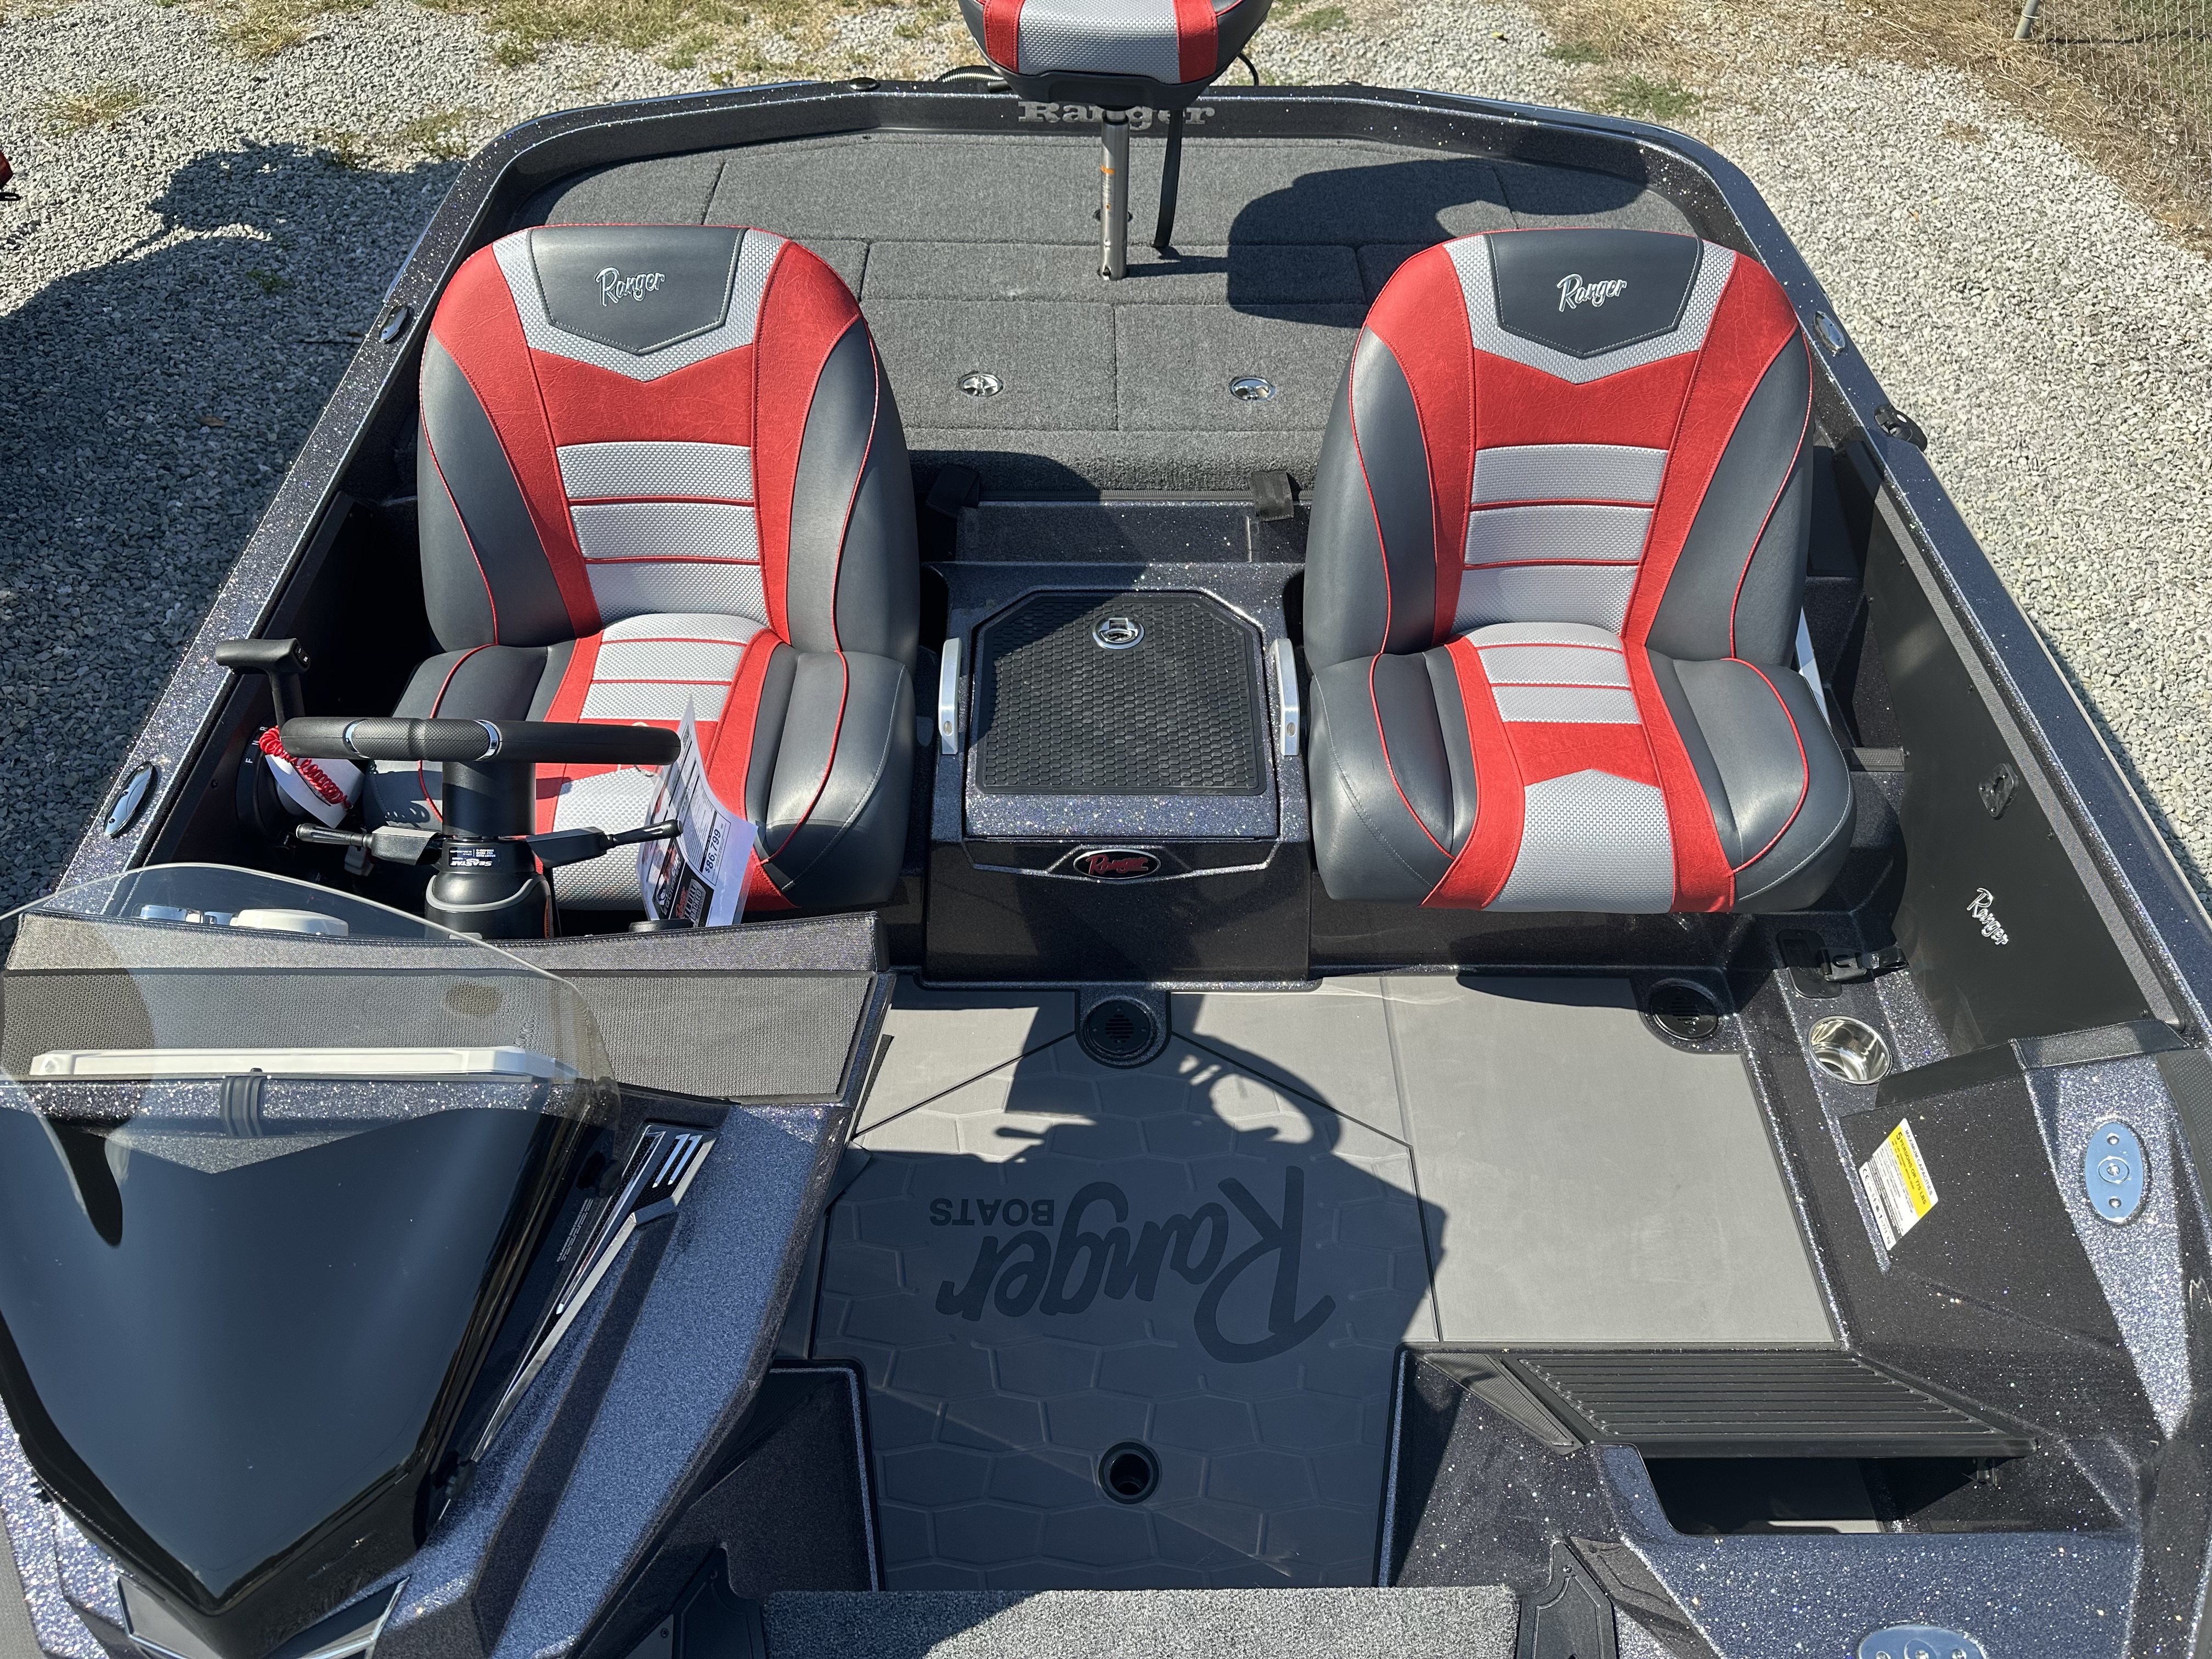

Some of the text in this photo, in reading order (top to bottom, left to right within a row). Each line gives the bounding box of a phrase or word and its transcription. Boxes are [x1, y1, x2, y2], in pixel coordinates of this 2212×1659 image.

[594, 267, 665, 307] Ranger
[1556, 274, 1627, 312] Ranger
[705, 829, 721, 873] $86,799
[1085, 854, 1148, 875] Ranger
[691, 889, 703, 921] BACKED
[1966, 888, 2008, 945] Ranger
[1896, 1131, 1903, 1140] 5
[1900, 1139, 1912, 1169] PERSONS
[1910, 1167, 1916, 1179] OR
[1905, 1128, 1933, 1196] MAXIMUM CAPACITIES
[929, 1198, 1055, 1227] BOATS
[935, 1166, 1336, 1364] Ranger
